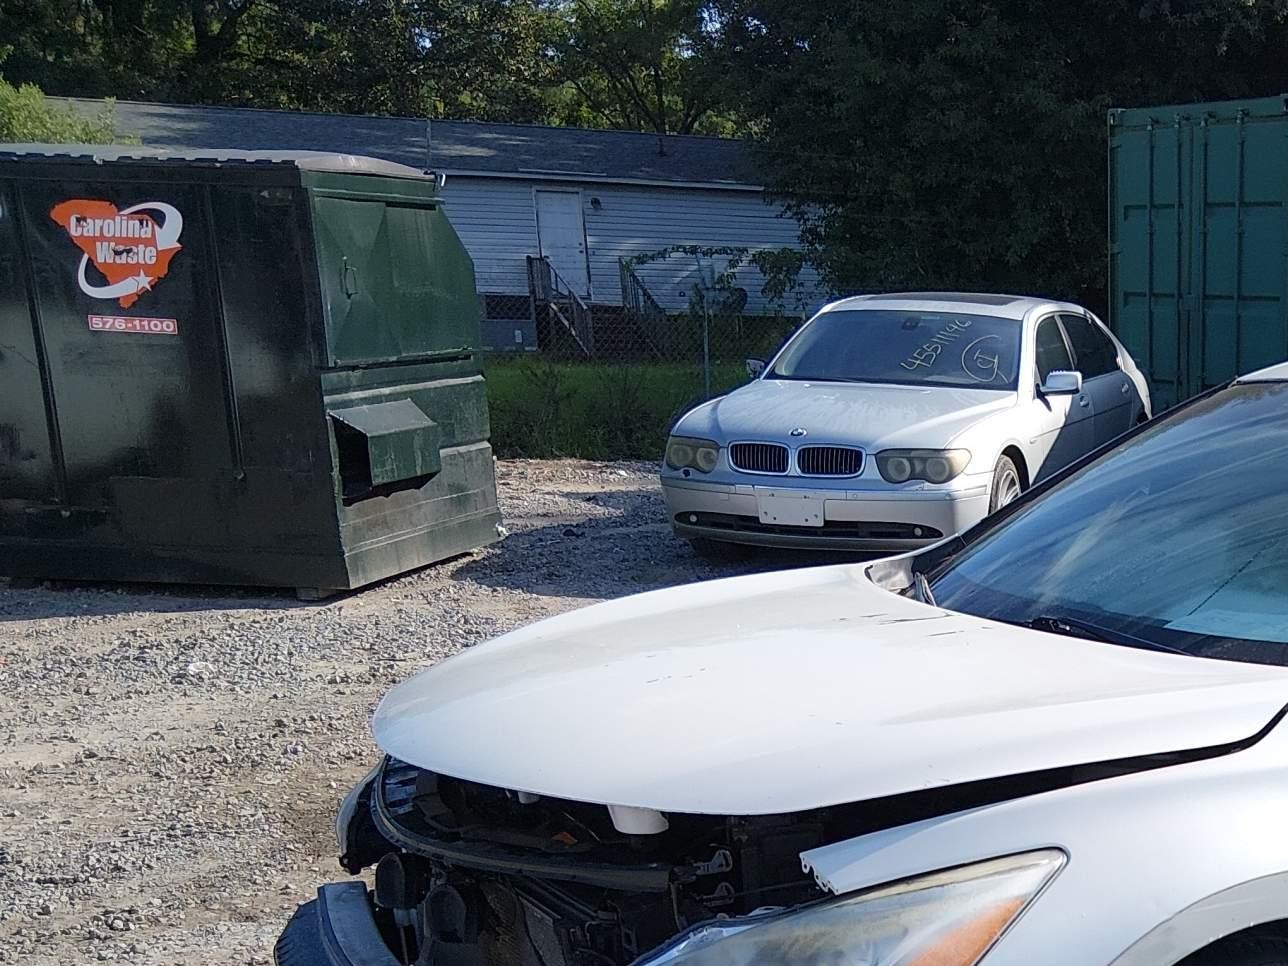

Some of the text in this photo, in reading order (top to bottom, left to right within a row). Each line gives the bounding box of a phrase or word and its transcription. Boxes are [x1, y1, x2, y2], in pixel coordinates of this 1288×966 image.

[70, 214, 152, 238] Carolina
[95, 241, 157, 264] Waste
[92, 318, 174, 331] 576-1100
